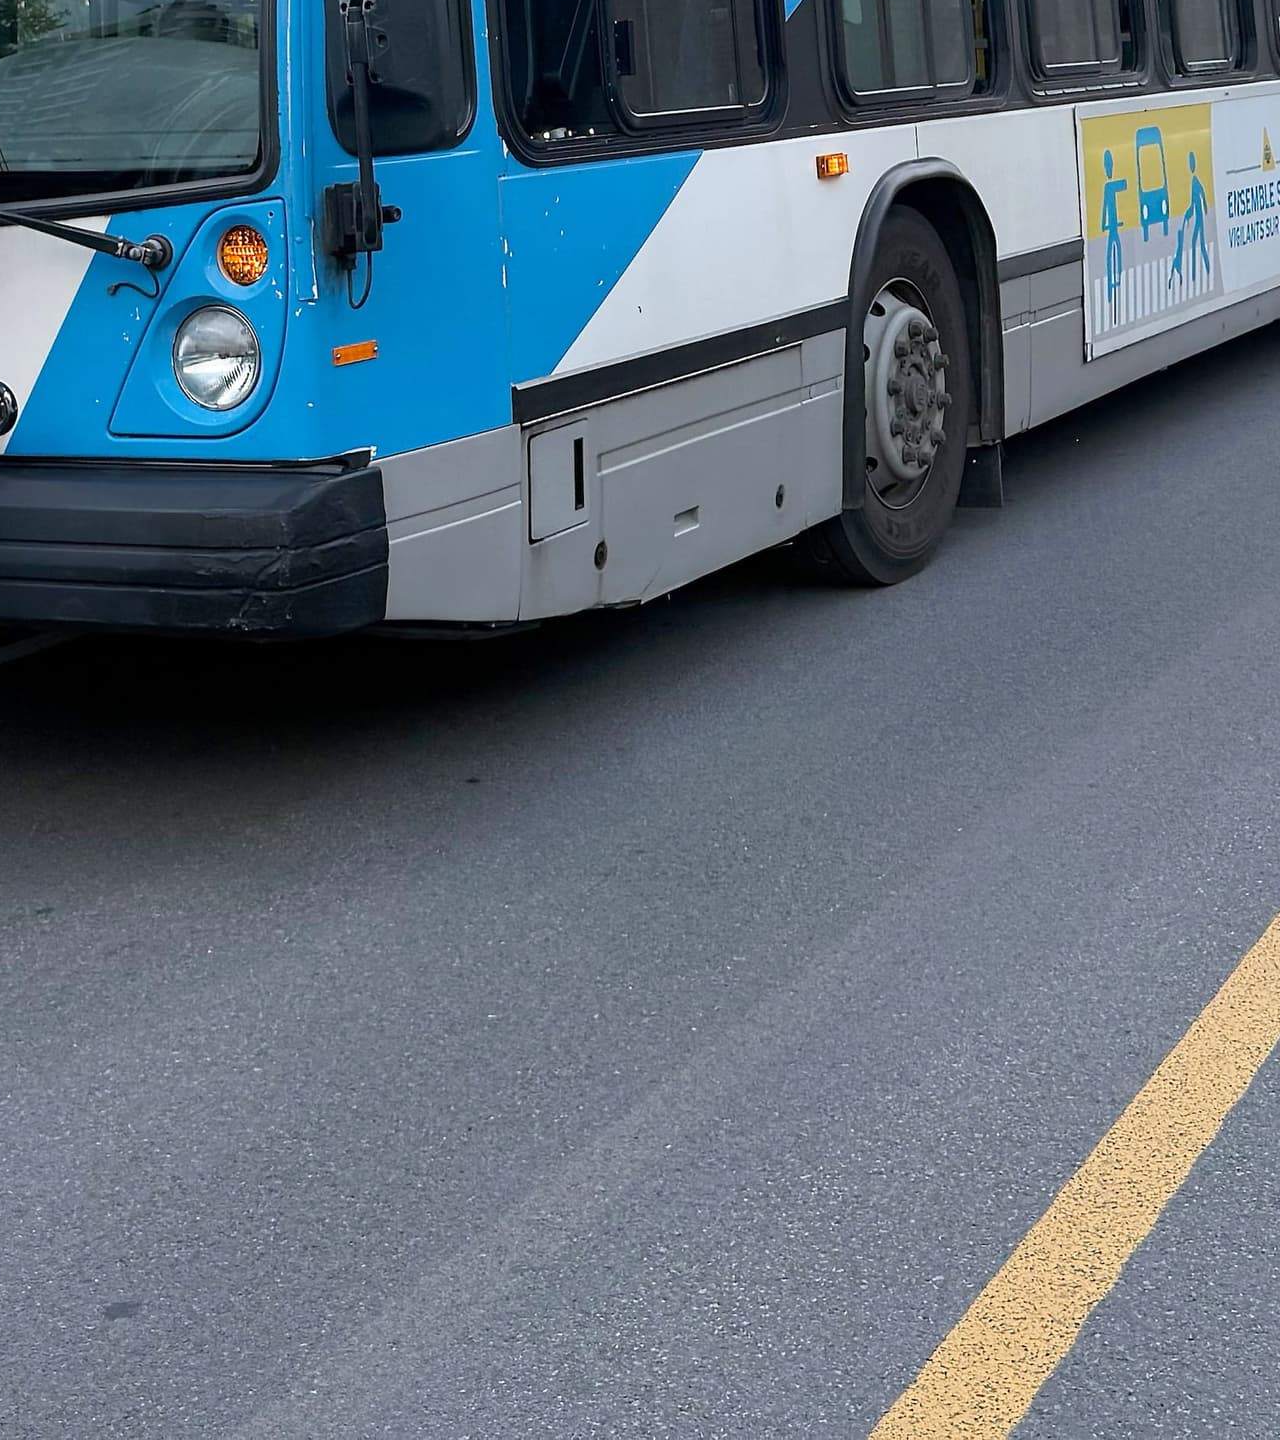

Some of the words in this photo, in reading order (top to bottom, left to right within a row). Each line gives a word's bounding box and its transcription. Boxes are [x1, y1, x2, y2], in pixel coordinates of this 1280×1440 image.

[1227, 181, 1275, 219] ENSEMBLE
[1228, 220, 1265, 248] VIGILANTS
[1265, 215, 1280, 238] SUR
